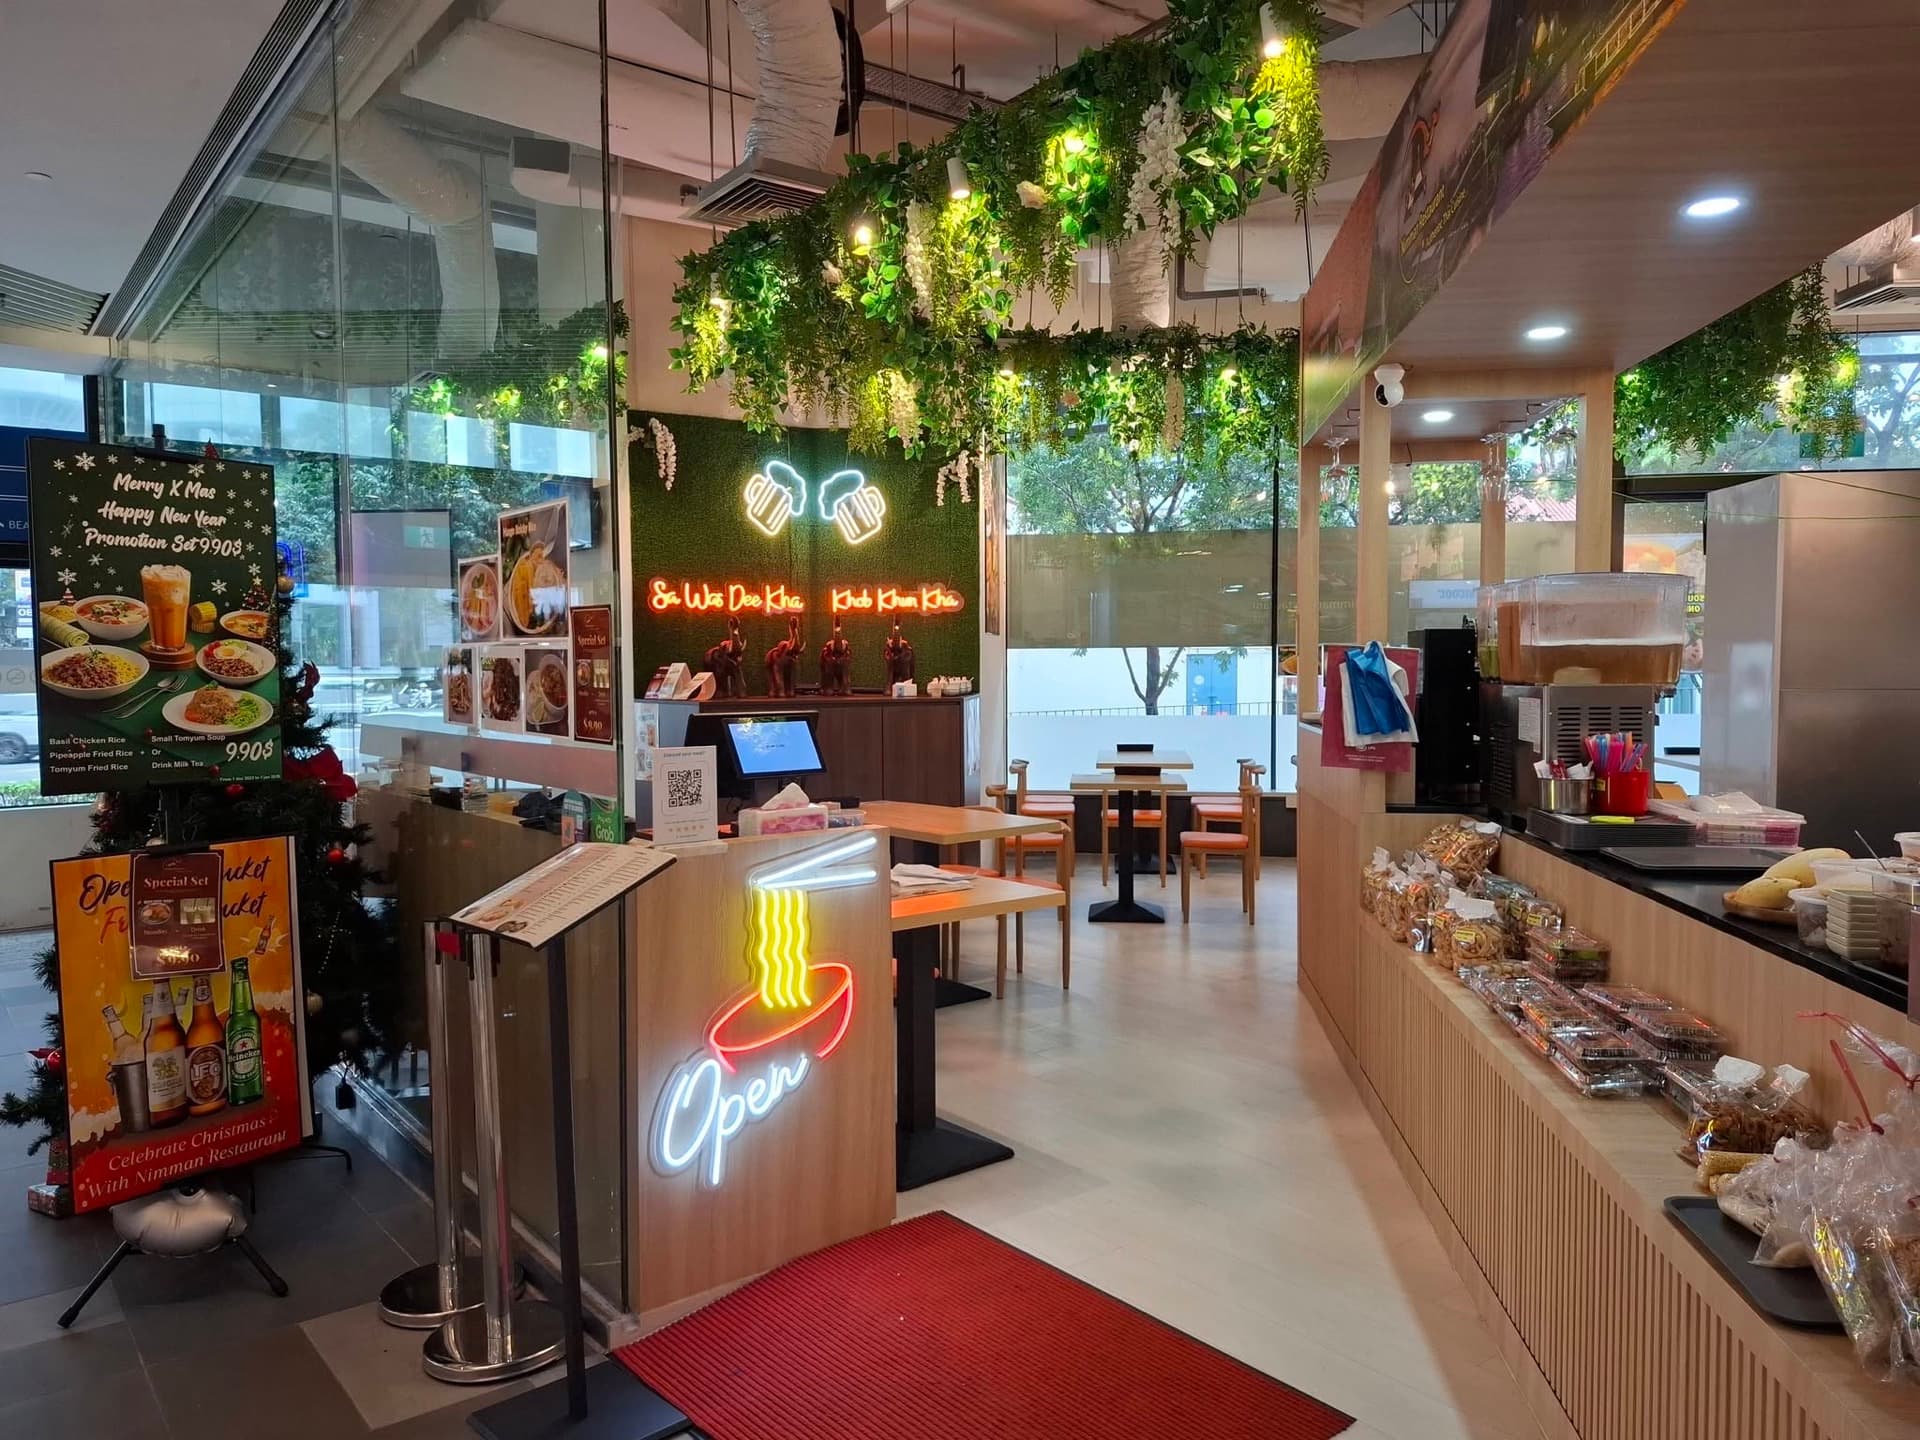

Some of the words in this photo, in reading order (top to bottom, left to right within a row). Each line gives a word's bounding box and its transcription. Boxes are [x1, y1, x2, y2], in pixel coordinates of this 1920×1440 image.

[113, 473, 164, 499] Merry
[169, 480, 183, 496] X
[184, 481, 216, 499] Mas
[9, 521, 29, 530] BEA
[98, 501, 155, 526] Happy
[160, 506, 191, 525] New
[194, 509, 227, 528] Year
[85, 528, 168, 550] Promotion
[171, 535, 200, 552] Set
[652, 581, 681, 609] Sa
[729, 584, 763, 612] Dee
[765, 584, 804, 613] Kha
[922, 587, 959, 612] Kha
[578, 635, 596, 649] Special
[597, 635, 606, 646] Set
[72, 737, 106, 745] Chicken
[151, 735, 173, 743] Small
[175, 735, 206, 744] Tomyum
[207, 734, 226, 743] Soup
[225, 739, 274, 762] 9.90$
[151, 748, 162, 756] Or
[50, 765, 86, 774] Tomyum
[88, 764, 109, 772] Fried
[110, 763, 129, 771] Rice
[174, 761, 190, 769] Milk
[191, 760, 204, 768] Tea
[222, 856, 271, 883] ucket
[79, 874, 130, 911] Ope
[144, 877, 187, 889] Special
[189, 876, 209, 887] Set
[223, 892, 266, 918] ucket
[662, 1053, 808, 1185] Open
[109, 1139, 186, 1171] Celebrate
[192, 1119, 266, 1148] Christmas
[89, 1175, 129, 1198] With
[136, 1156, 204, 1185] Nimman
[209, 1130, 286, 1164] Restaurant
